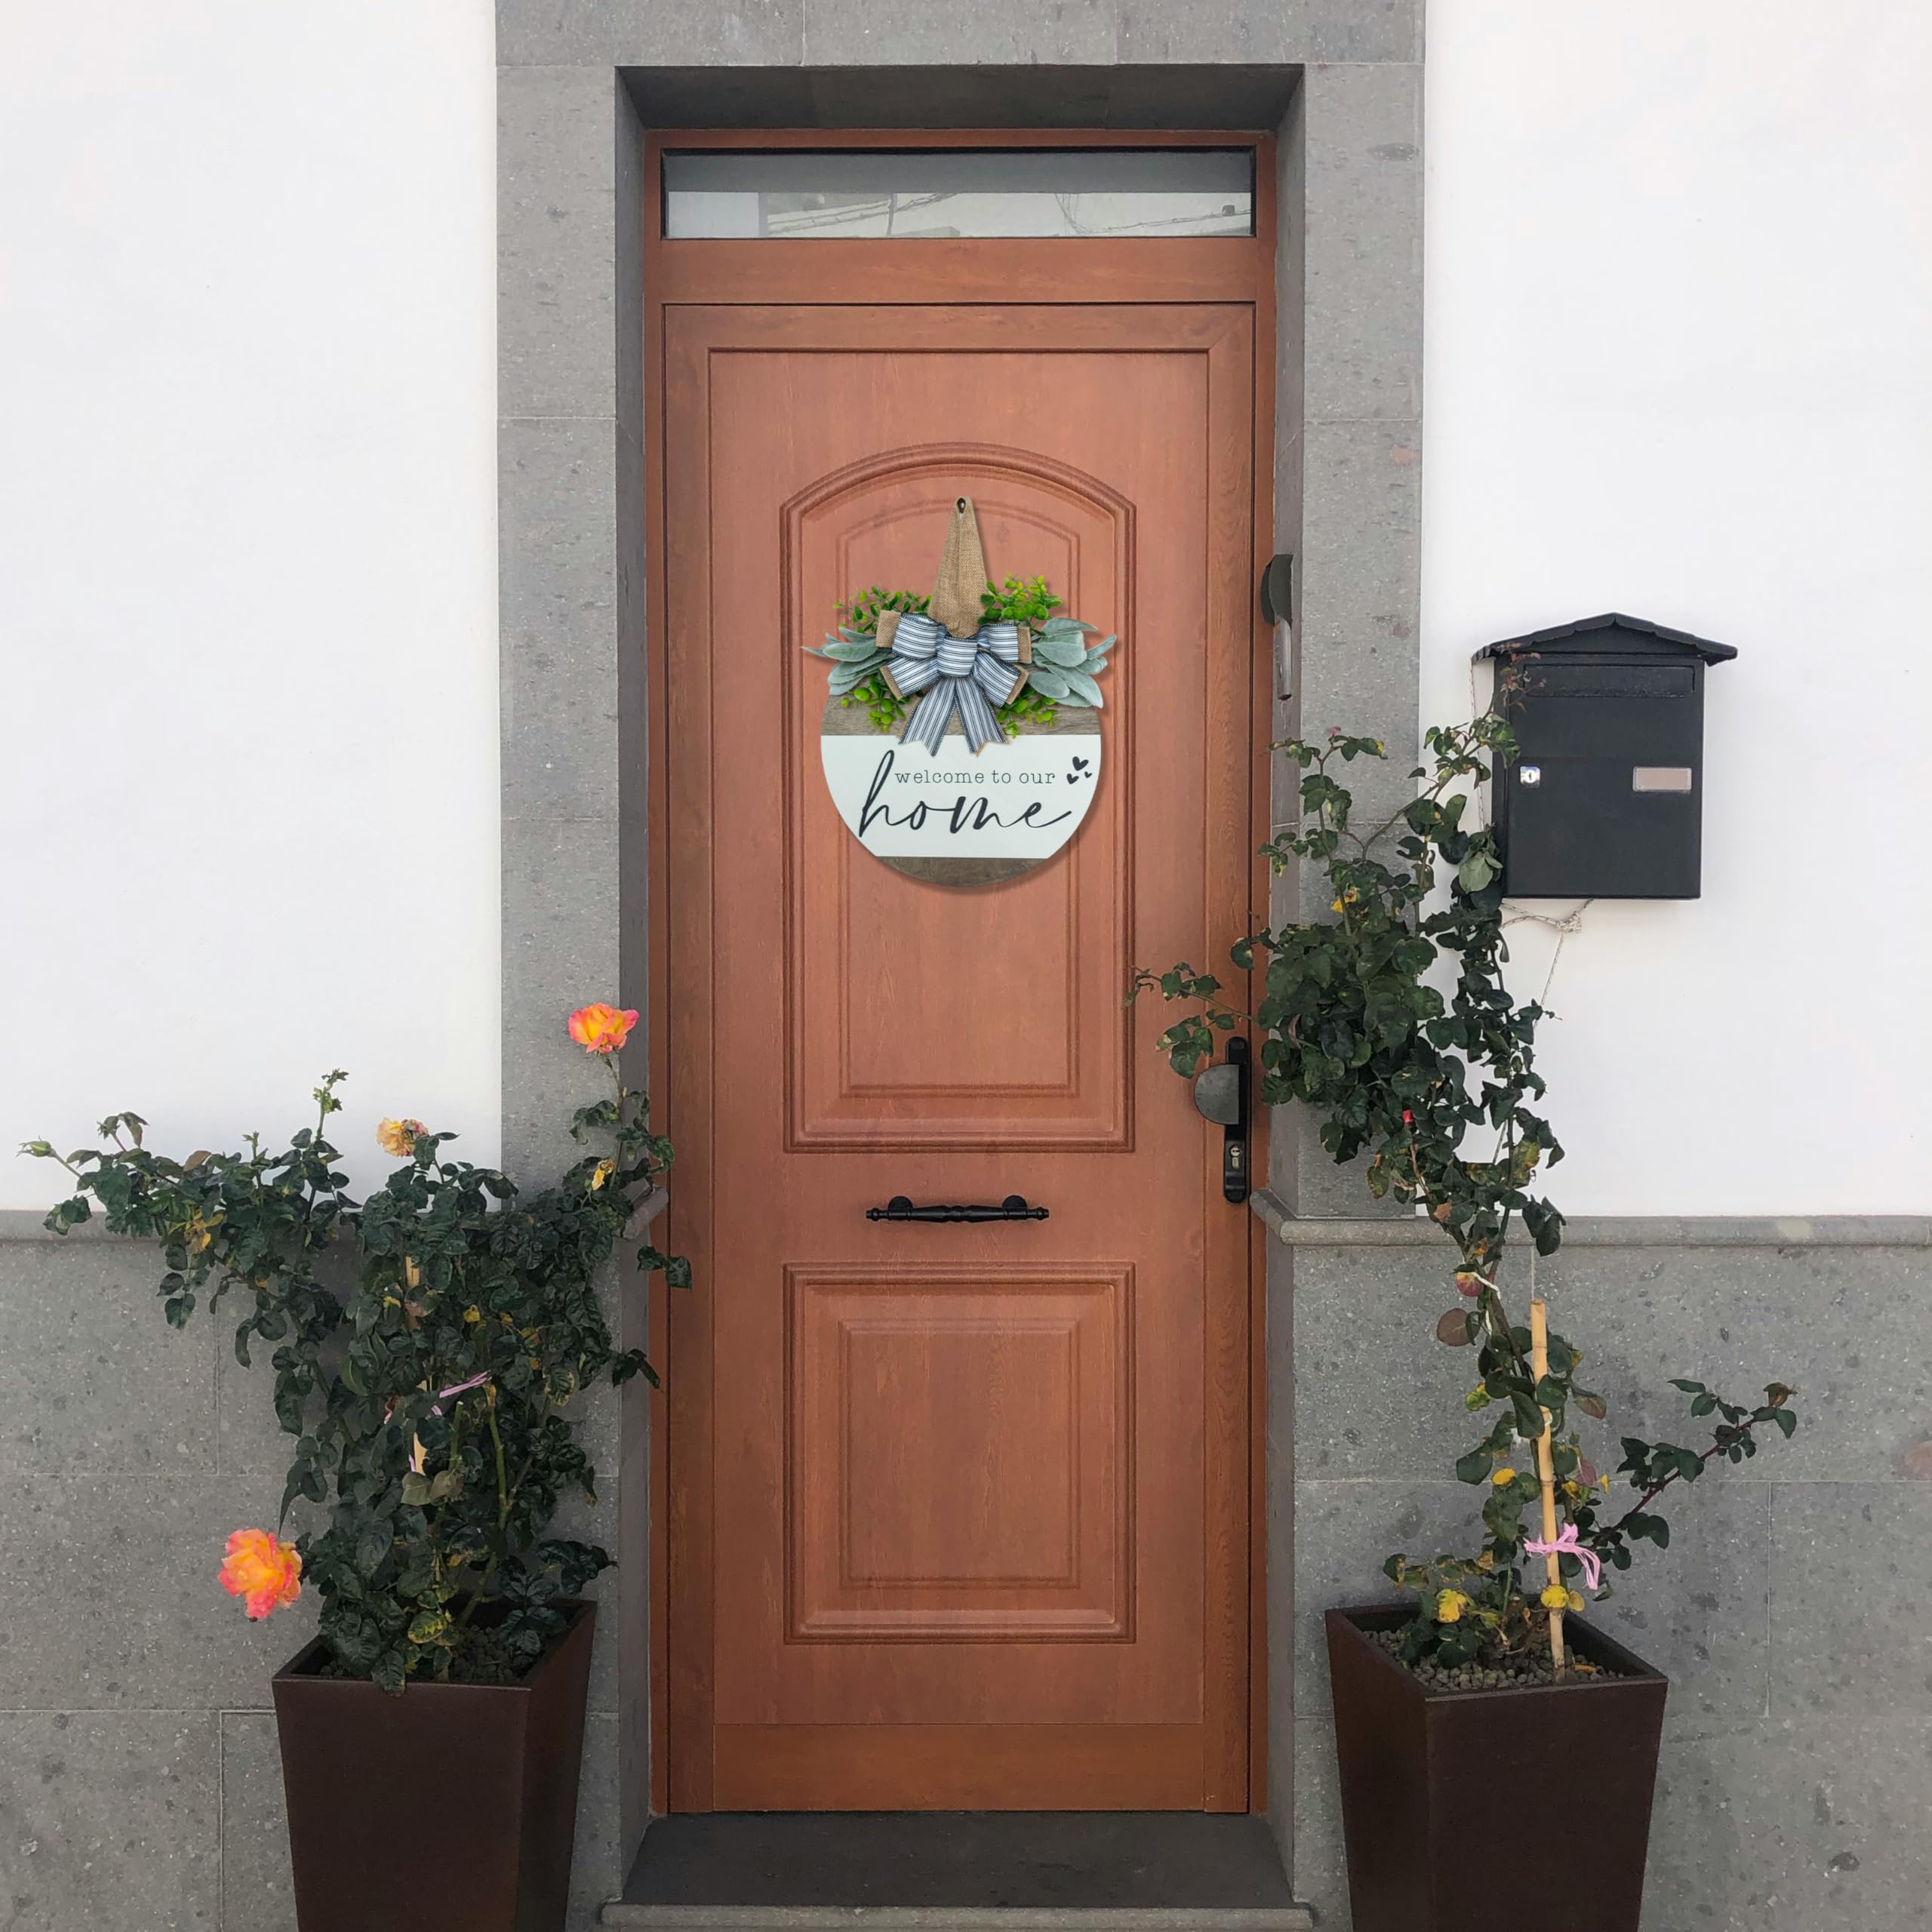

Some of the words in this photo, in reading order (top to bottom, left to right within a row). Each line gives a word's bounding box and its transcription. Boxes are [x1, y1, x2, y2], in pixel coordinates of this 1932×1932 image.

[858, 749, 1072, 838] home
[895, 770, 984, 784] welcome
[992, 770, 1011, 784] to
[1019, 773, 1056, 784] our
